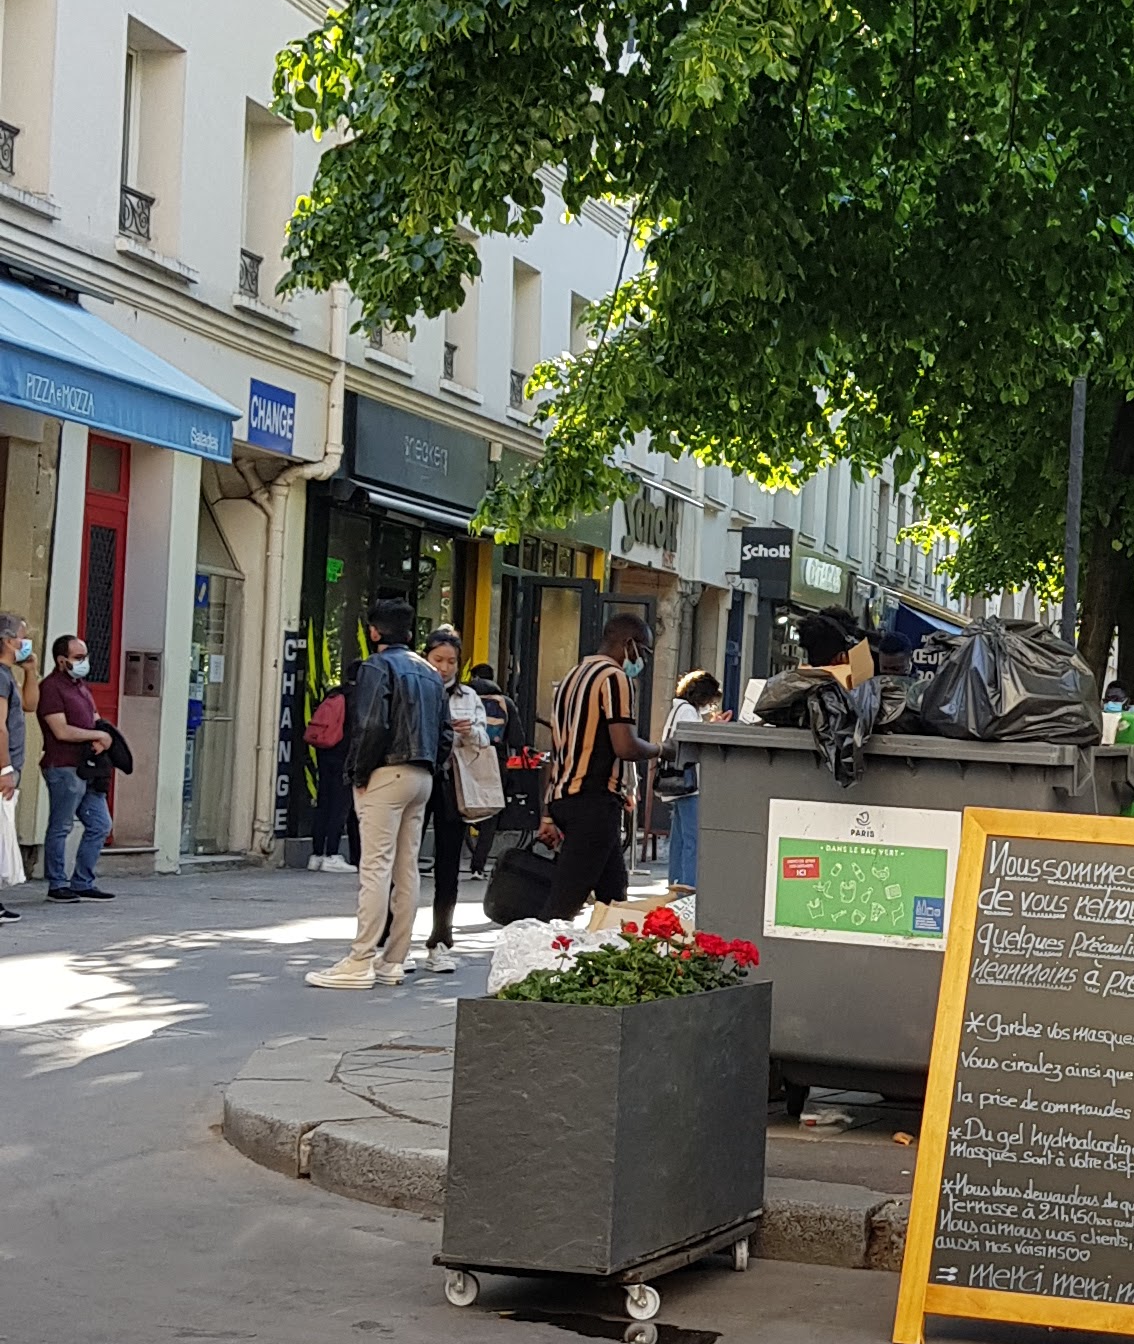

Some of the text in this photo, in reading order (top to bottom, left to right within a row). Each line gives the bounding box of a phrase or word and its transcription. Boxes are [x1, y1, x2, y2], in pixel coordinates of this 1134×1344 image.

[26, 373, 57, 406] PIZZA
[62, 384, 95, 417] MOZZA
[250, 395, 294, 438] CHANGE
[190, 426, 219, 451] Salades
[742, 543, 791, 561] Schott
[273, 638, 298, 831] CHANGE
[851, 828, 875, 838] PARIS
[825, 844, 847, 853] DANS
[849, 846, 858, 854] LE
[861, 847, 877, 855] BAC
[989, 840, 1041, 877] Nous
[978, 878, 1014, 911] de
[1021, 891, 1070, 913] vous
[1083, 959, 1103, 987] à
[1064, 1062, 1101, 1078] ainsi
[1102, 1068, 1134, 1087] que
[957, 1081, 974, 1104] la
[979, 1088, 1018, 1110] prise
[1019, 1088, 1039, 1111] de
[961, 1117, 994, 1142] Du
[988, 1122, 1024, 1153] gel
[1055, 1151, 1066, 1167] à
[955, 1172, 991, 1197] Nous
[1101, 1191, 1119, 1209] de
[948, 1193, 1019, 1218] terrasse
[1021, 1201, 1036, 1220] à
[939, 1208, 979, 1234] Nous
[935, 1235, 980, 1252] aussi
[985, 1240, 1012, 1254] nos
